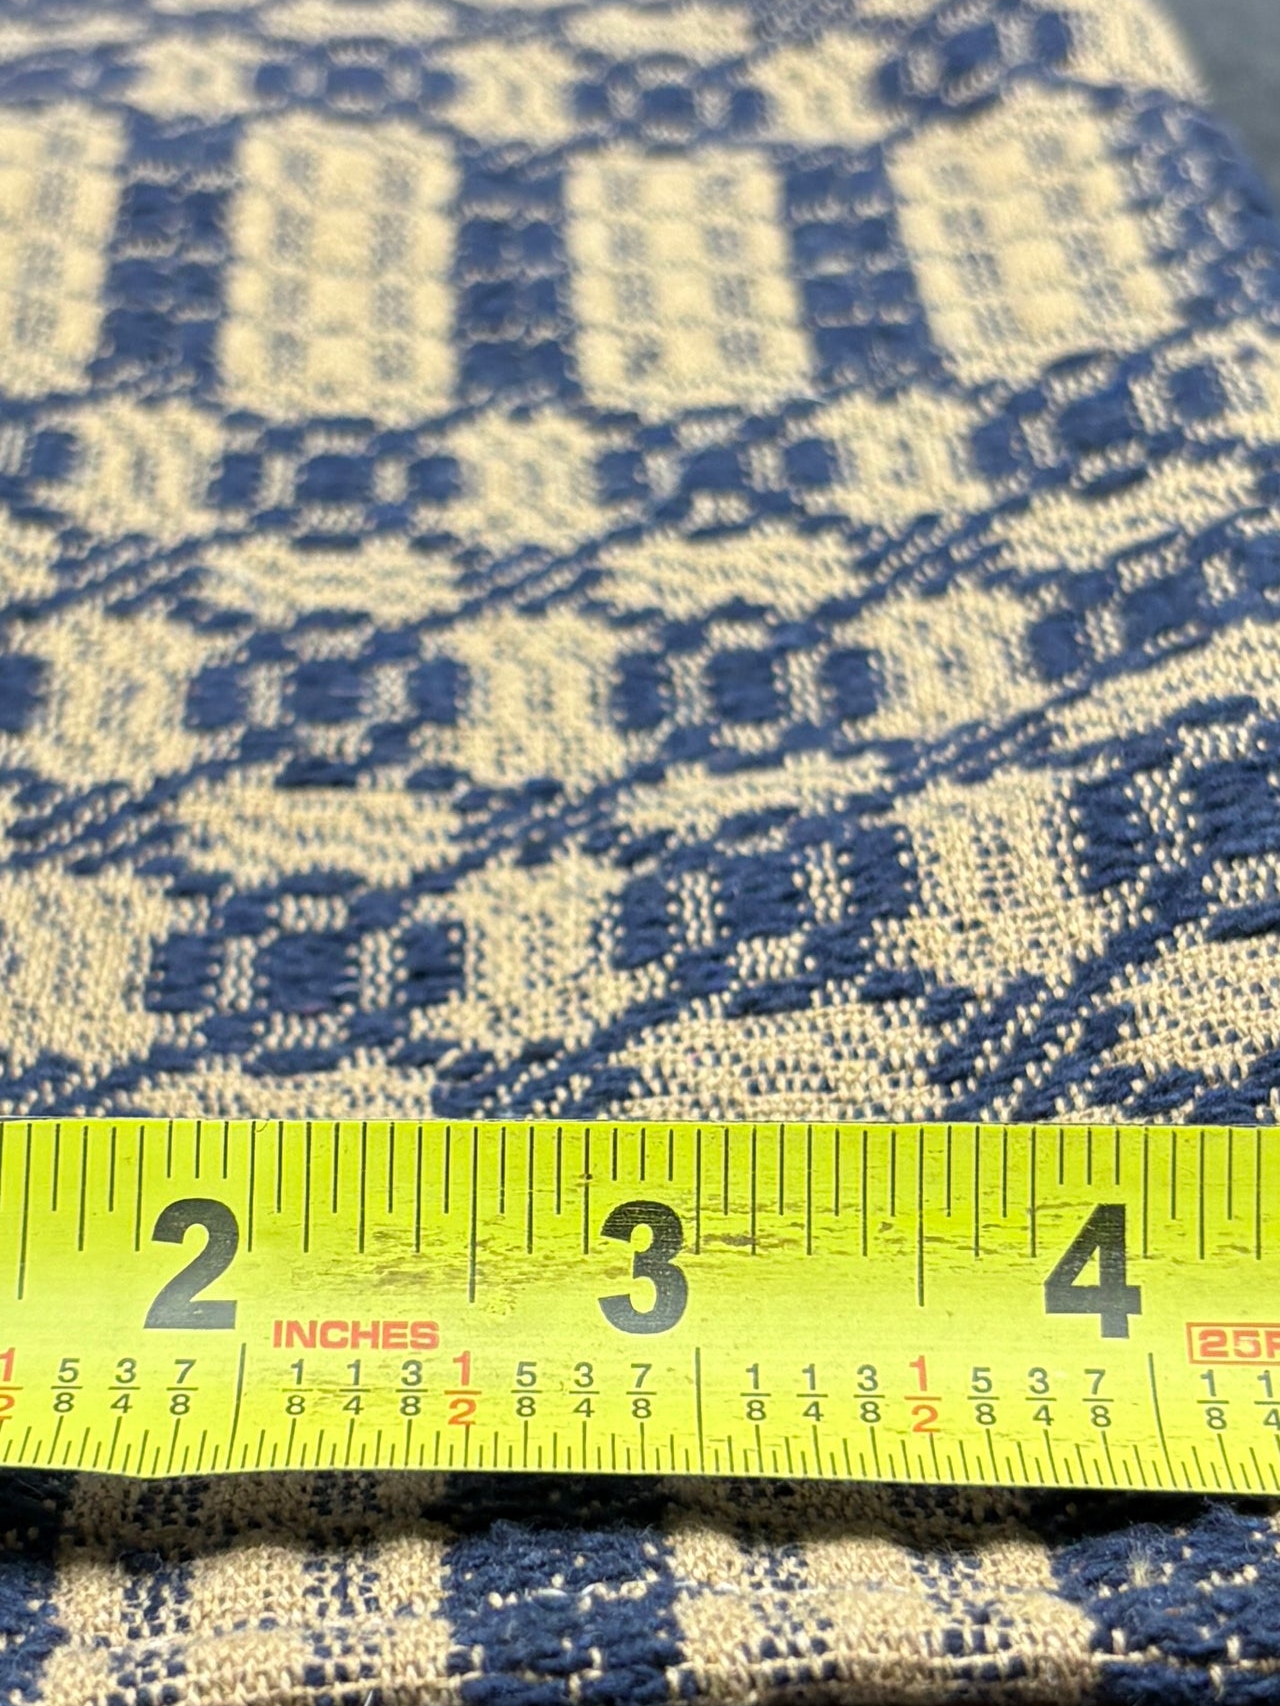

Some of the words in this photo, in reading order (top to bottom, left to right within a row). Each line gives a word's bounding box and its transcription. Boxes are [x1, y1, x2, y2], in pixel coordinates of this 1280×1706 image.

[143, 1198, 240, 1330] 2
[598, 1199, 688, 1334] 3
[1043, 1203, 1143, 1339] 4
[273, 1319, 440, 1350] INCHES
